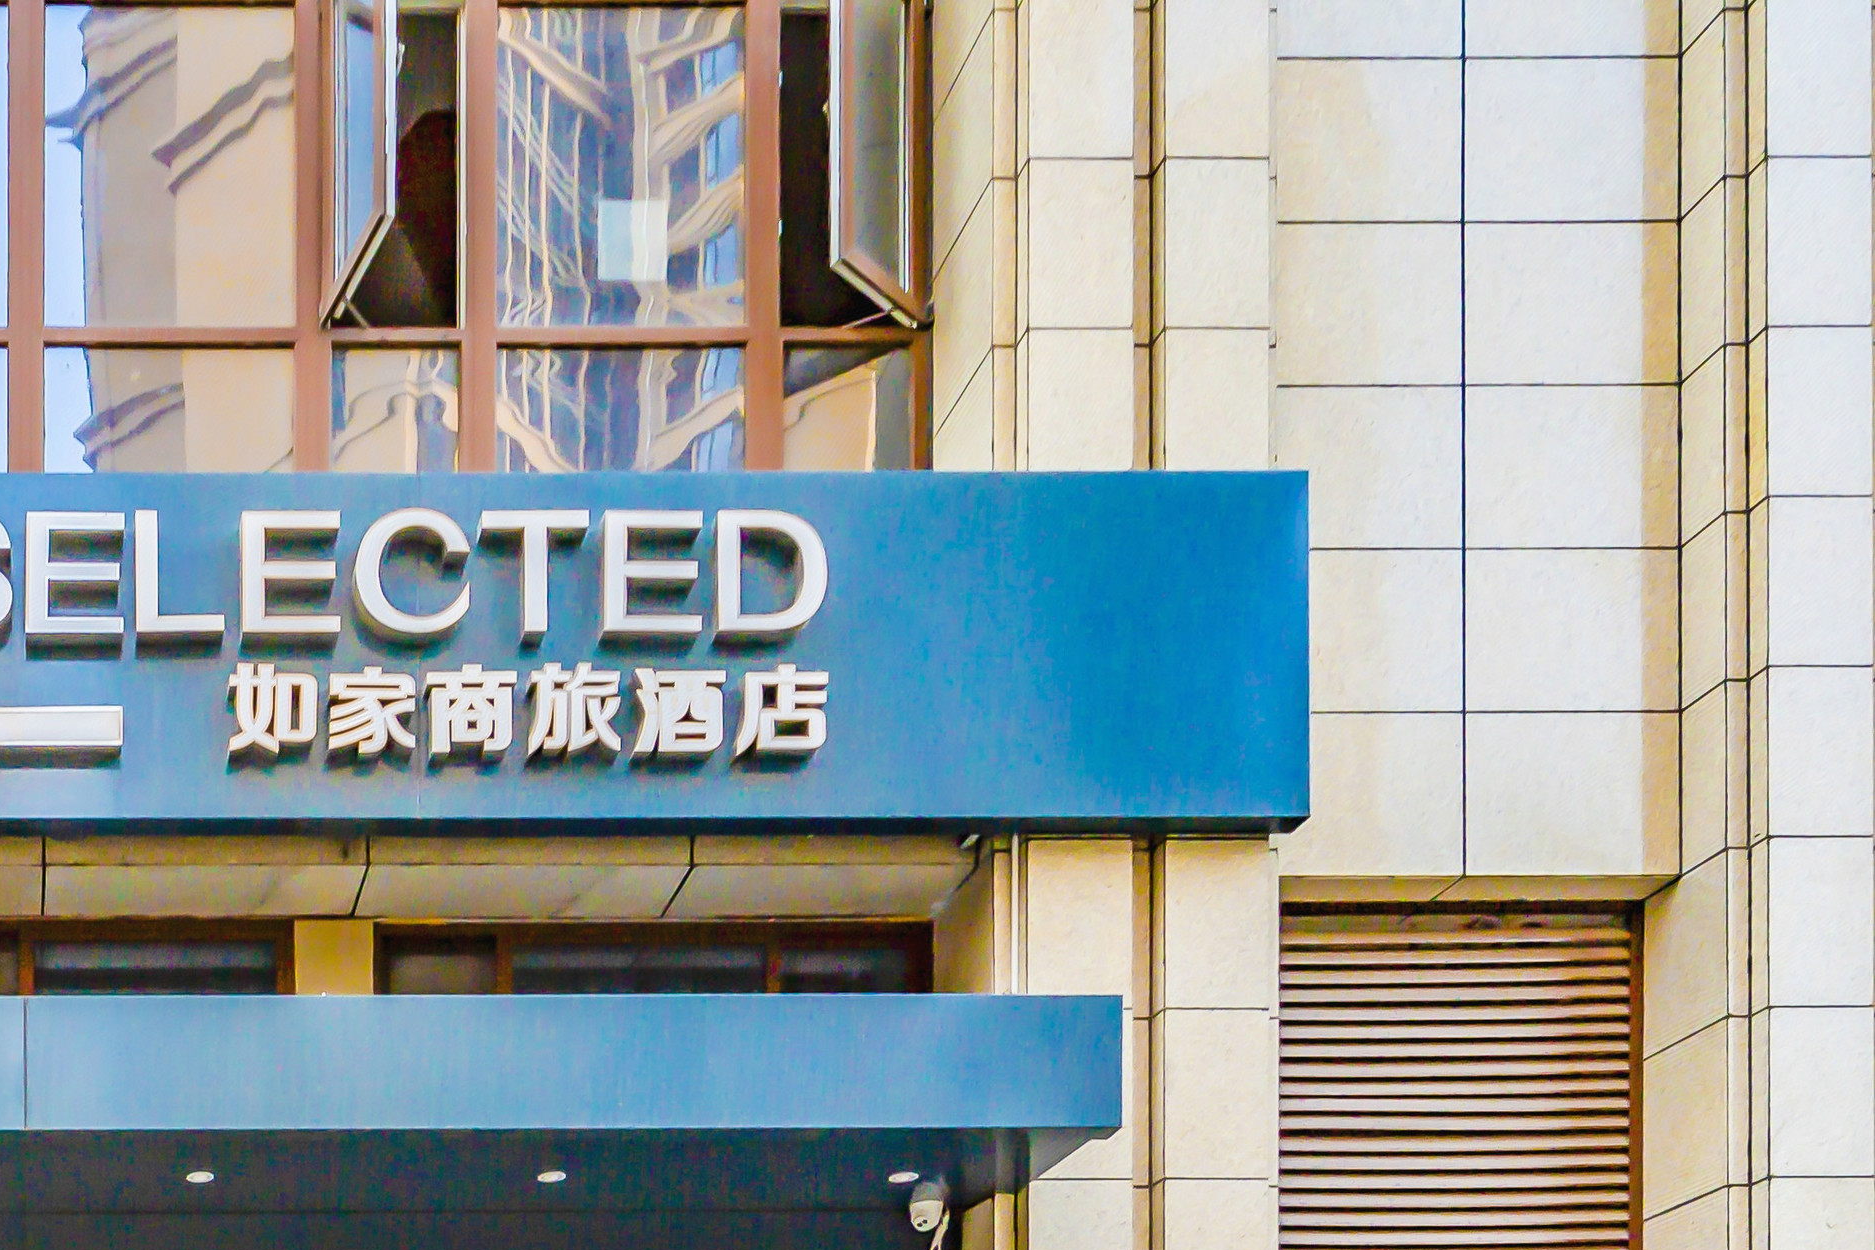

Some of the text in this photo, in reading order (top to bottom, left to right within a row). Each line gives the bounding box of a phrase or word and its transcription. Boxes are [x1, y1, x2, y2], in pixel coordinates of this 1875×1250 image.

[228, 662, 830, 755] 如家商旅酒店
